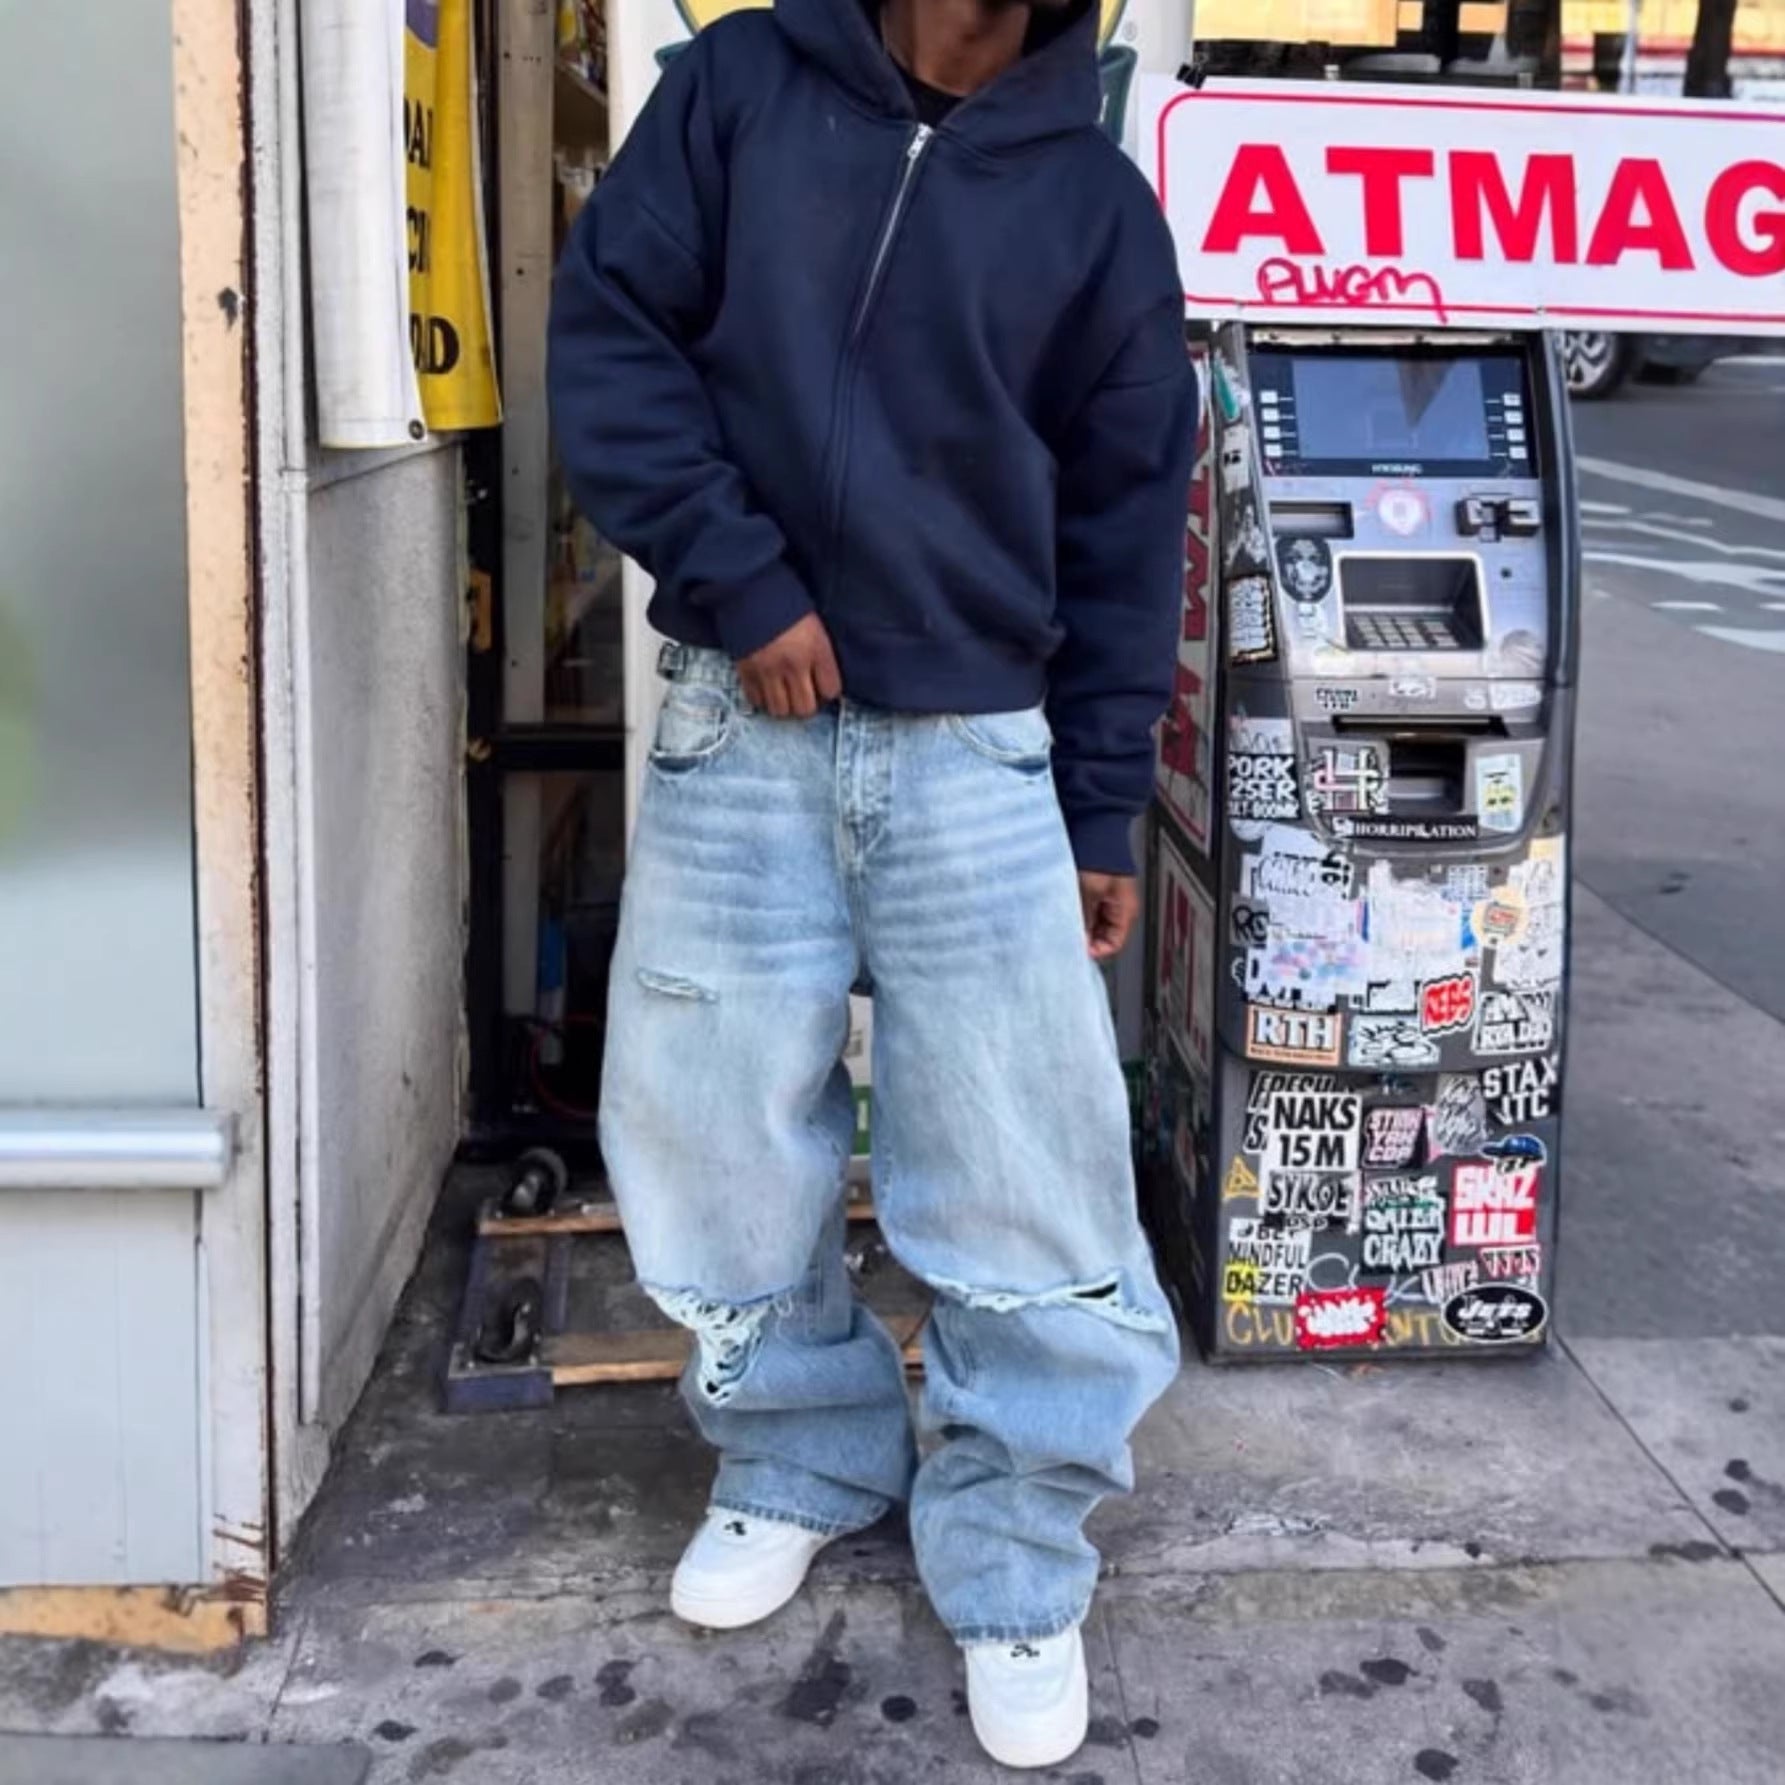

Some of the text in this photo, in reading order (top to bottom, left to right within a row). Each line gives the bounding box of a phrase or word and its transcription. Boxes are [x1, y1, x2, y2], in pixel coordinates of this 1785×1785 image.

[1256, 1012, 1334, 1050] RTH
[1483, 1055, 1560, 1099] STAX
[1273, 1096, 1355, 1130] NAKS
[1363, 1233, 1441, 1272] CRAZY
[1226, 1271, 1303, 1296] DAZER
